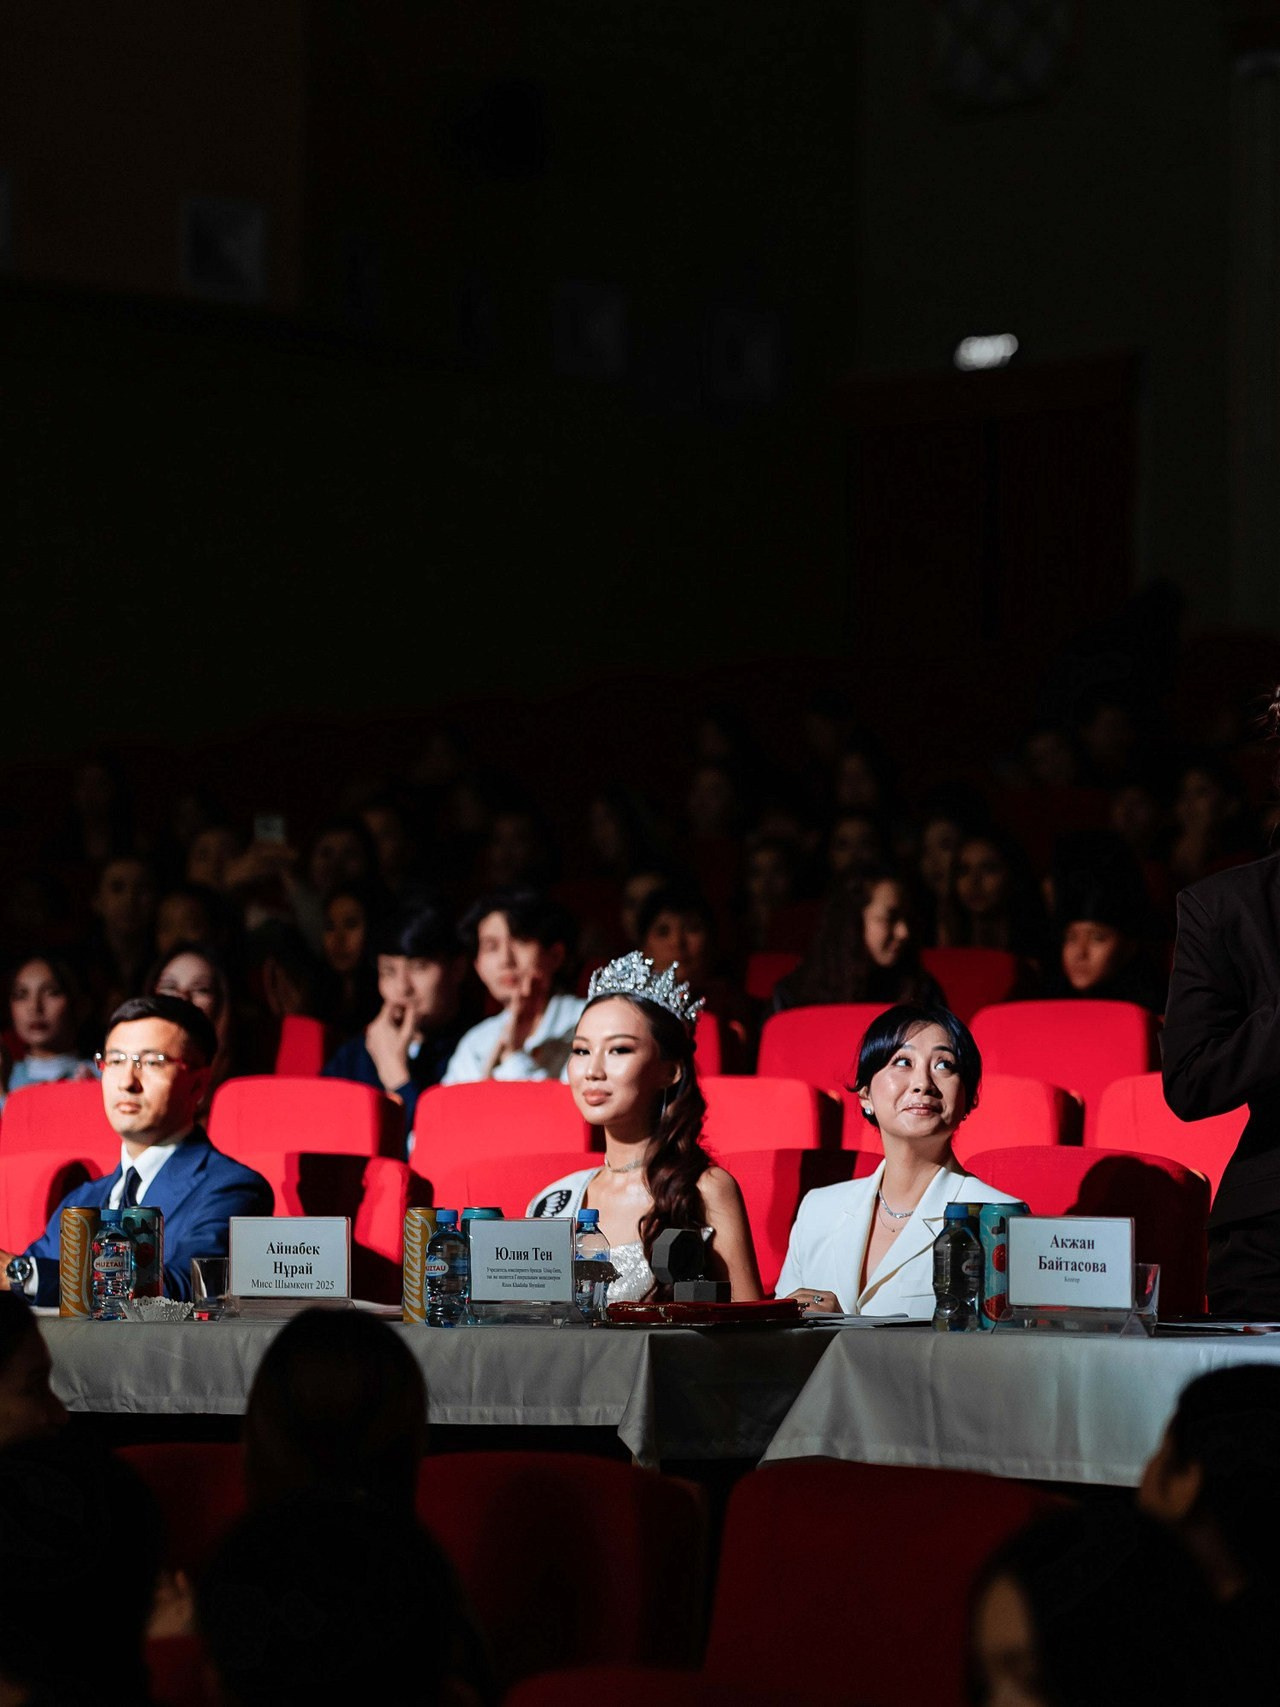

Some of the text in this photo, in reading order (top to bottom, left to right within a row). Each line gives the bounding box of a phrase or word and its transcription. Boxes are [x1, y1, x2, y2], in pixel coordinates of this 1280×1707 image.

[266, 1242, 320, 1255] Айнабек
[1050, 1233, 1095, 1250] Акжан
[495, 1247, 552, 1261] Юлия Тен
[273, 1261, 313, 1278] Нұрай
[1037, 1255, 1107, 1273] Байтасова
[251, 1279, 335, 1290] Мисс Шымкент 2025
